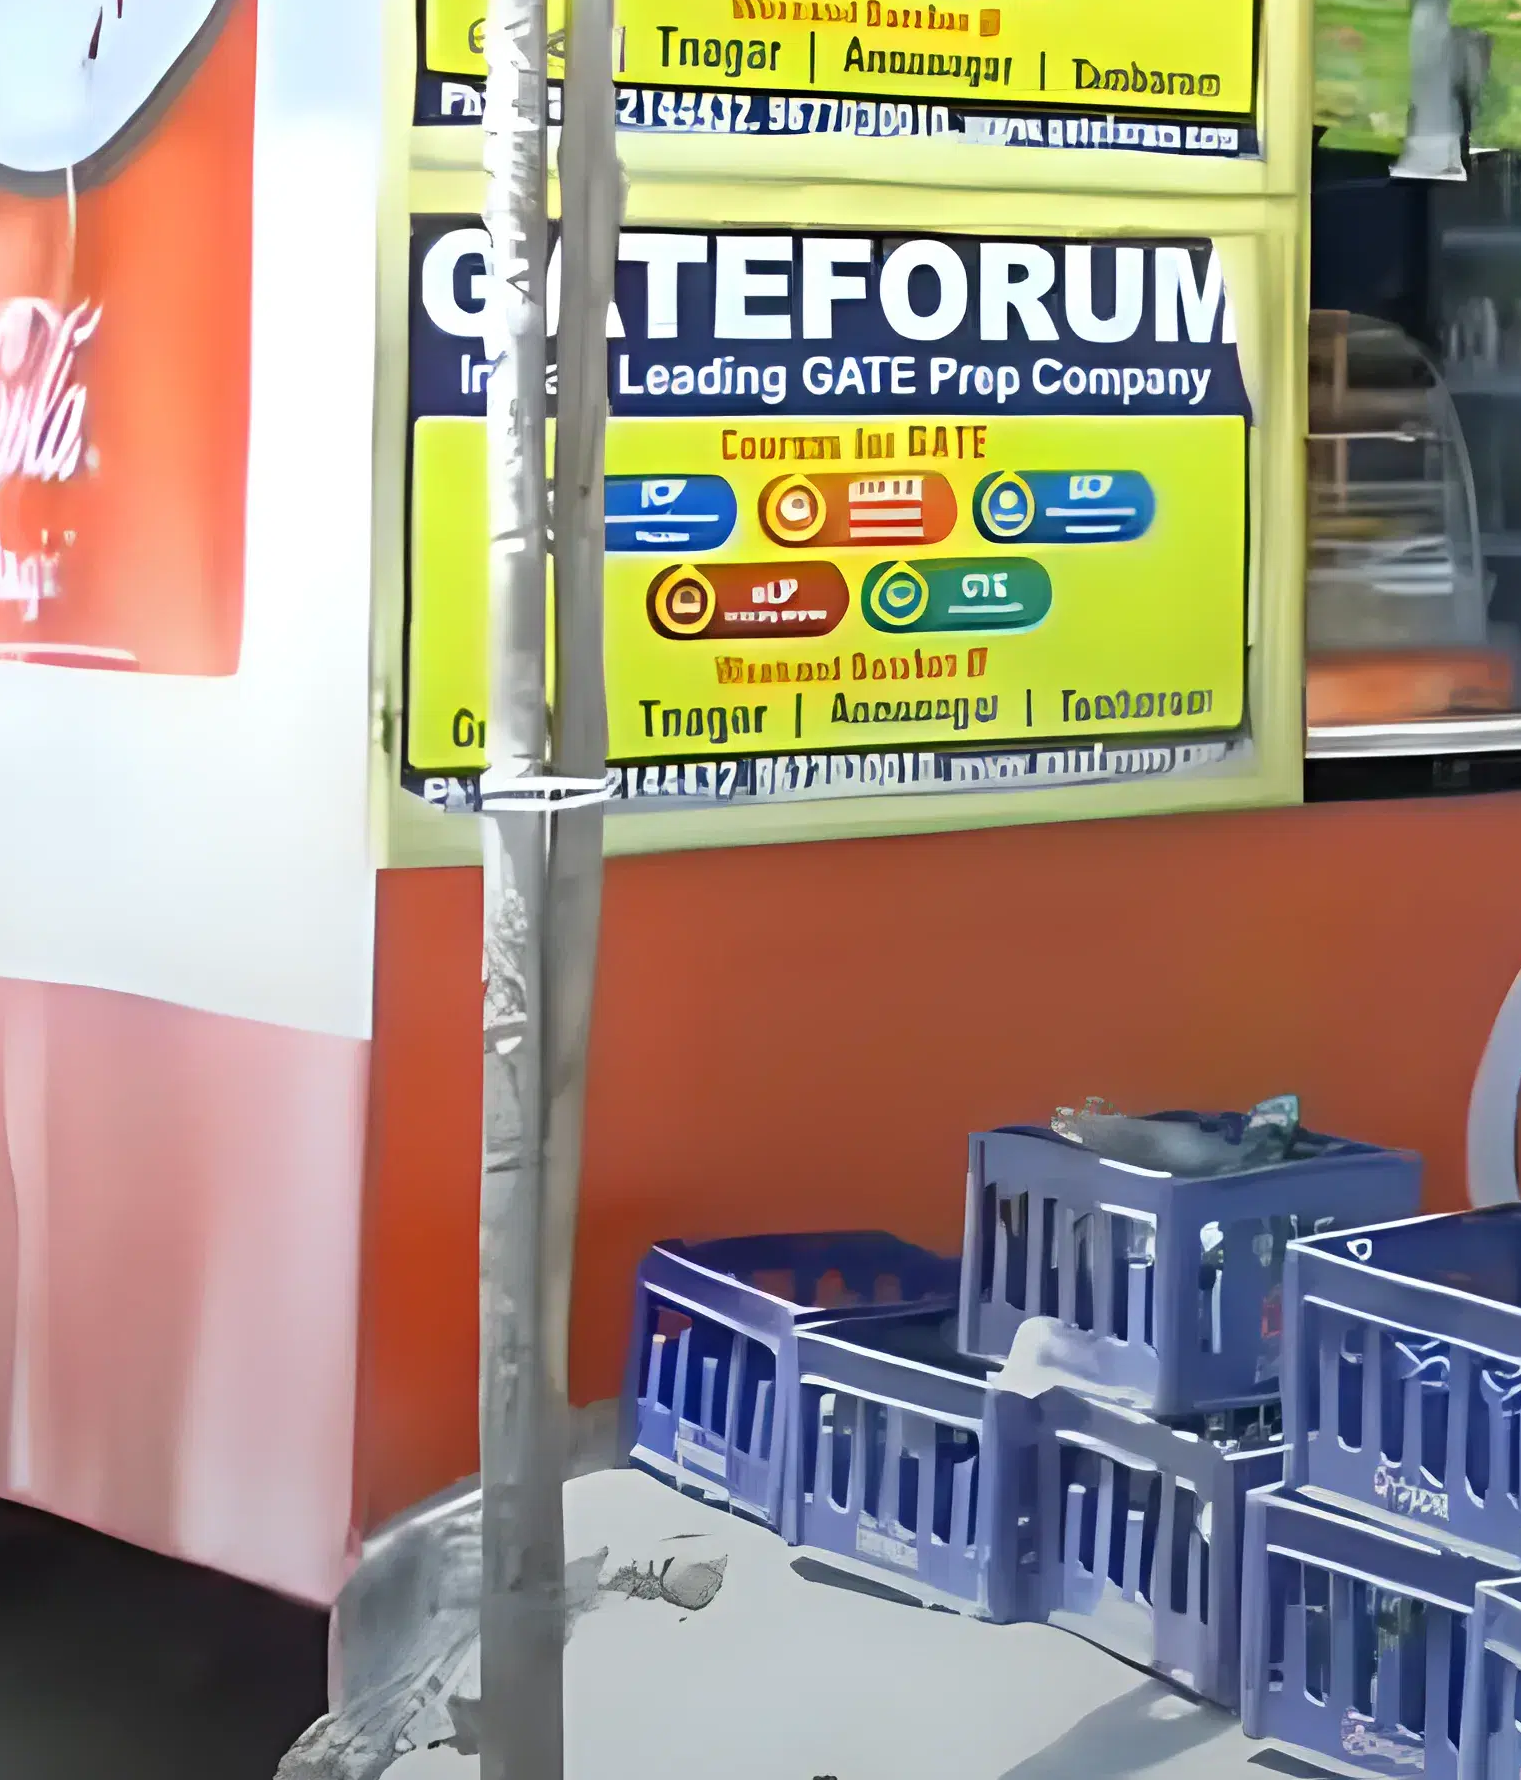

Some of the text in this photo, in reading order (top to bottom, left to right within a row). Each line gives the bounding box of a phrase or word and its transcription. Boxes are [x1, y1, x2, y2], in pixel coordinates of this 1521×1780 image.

[656, 25, 781, 77] Tnagar
[619, 353, 1212, 405] Leading GATE Prep Company
[639, 699, 767, 744] Tnagar
